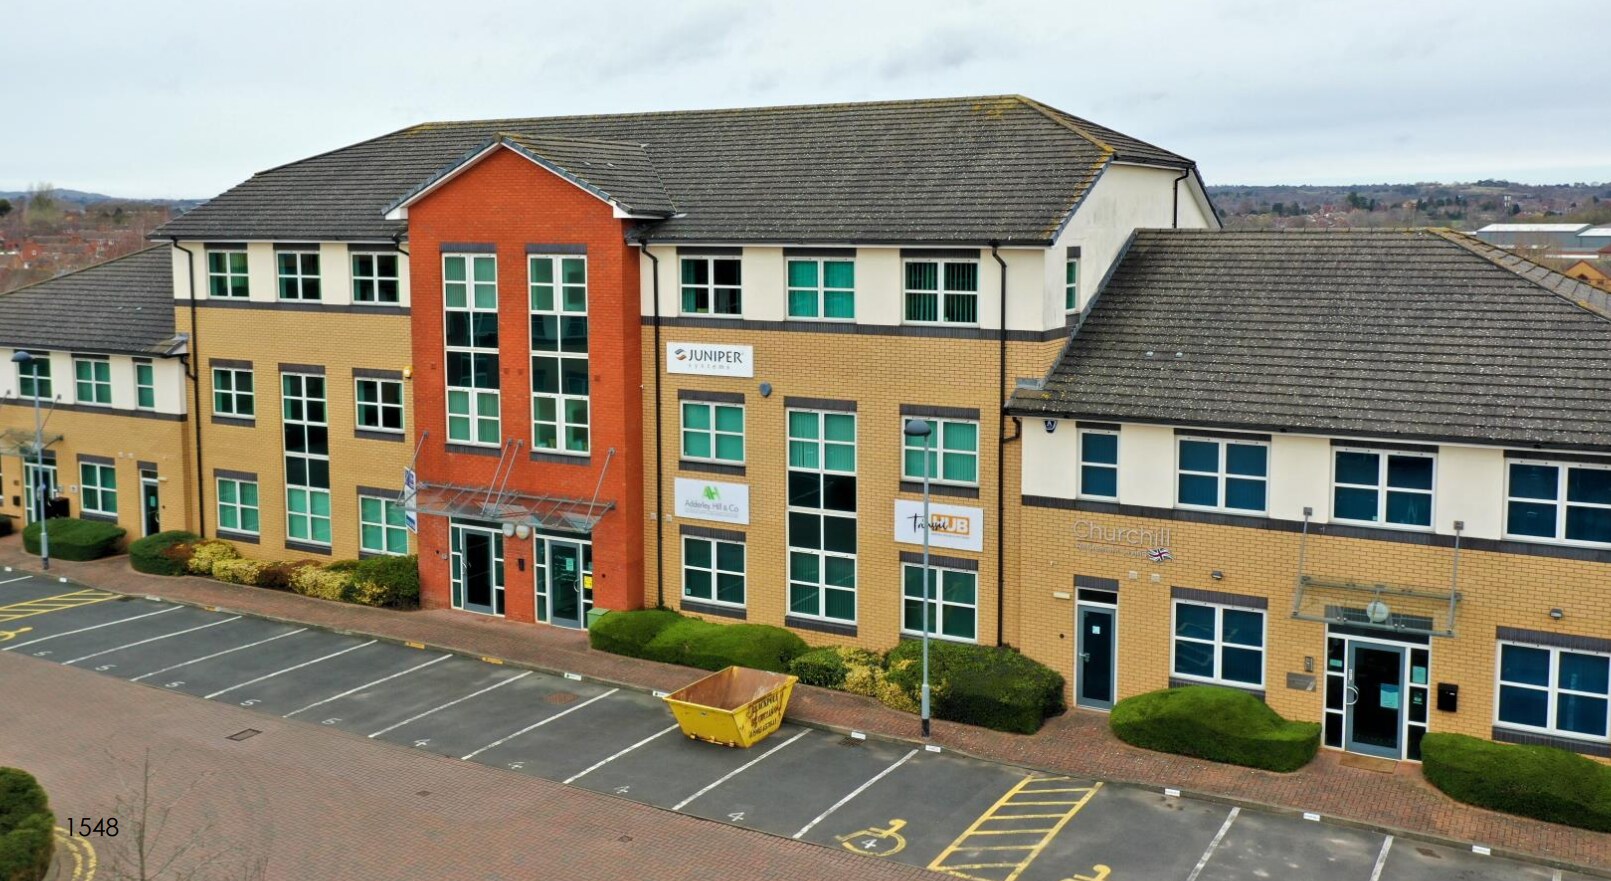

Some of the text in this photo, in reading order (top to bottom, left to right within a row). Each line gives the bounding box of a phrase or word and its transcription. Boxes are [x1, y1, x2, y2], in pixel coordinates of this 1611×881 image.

[688, 349, 743, 363] JUNIPER
[728, 504, 740, 513] Co
[1074, 519, 1171, 547] Churchill
[727, 811, 745, 822] 4
[860, 838, 878, 849] 4
